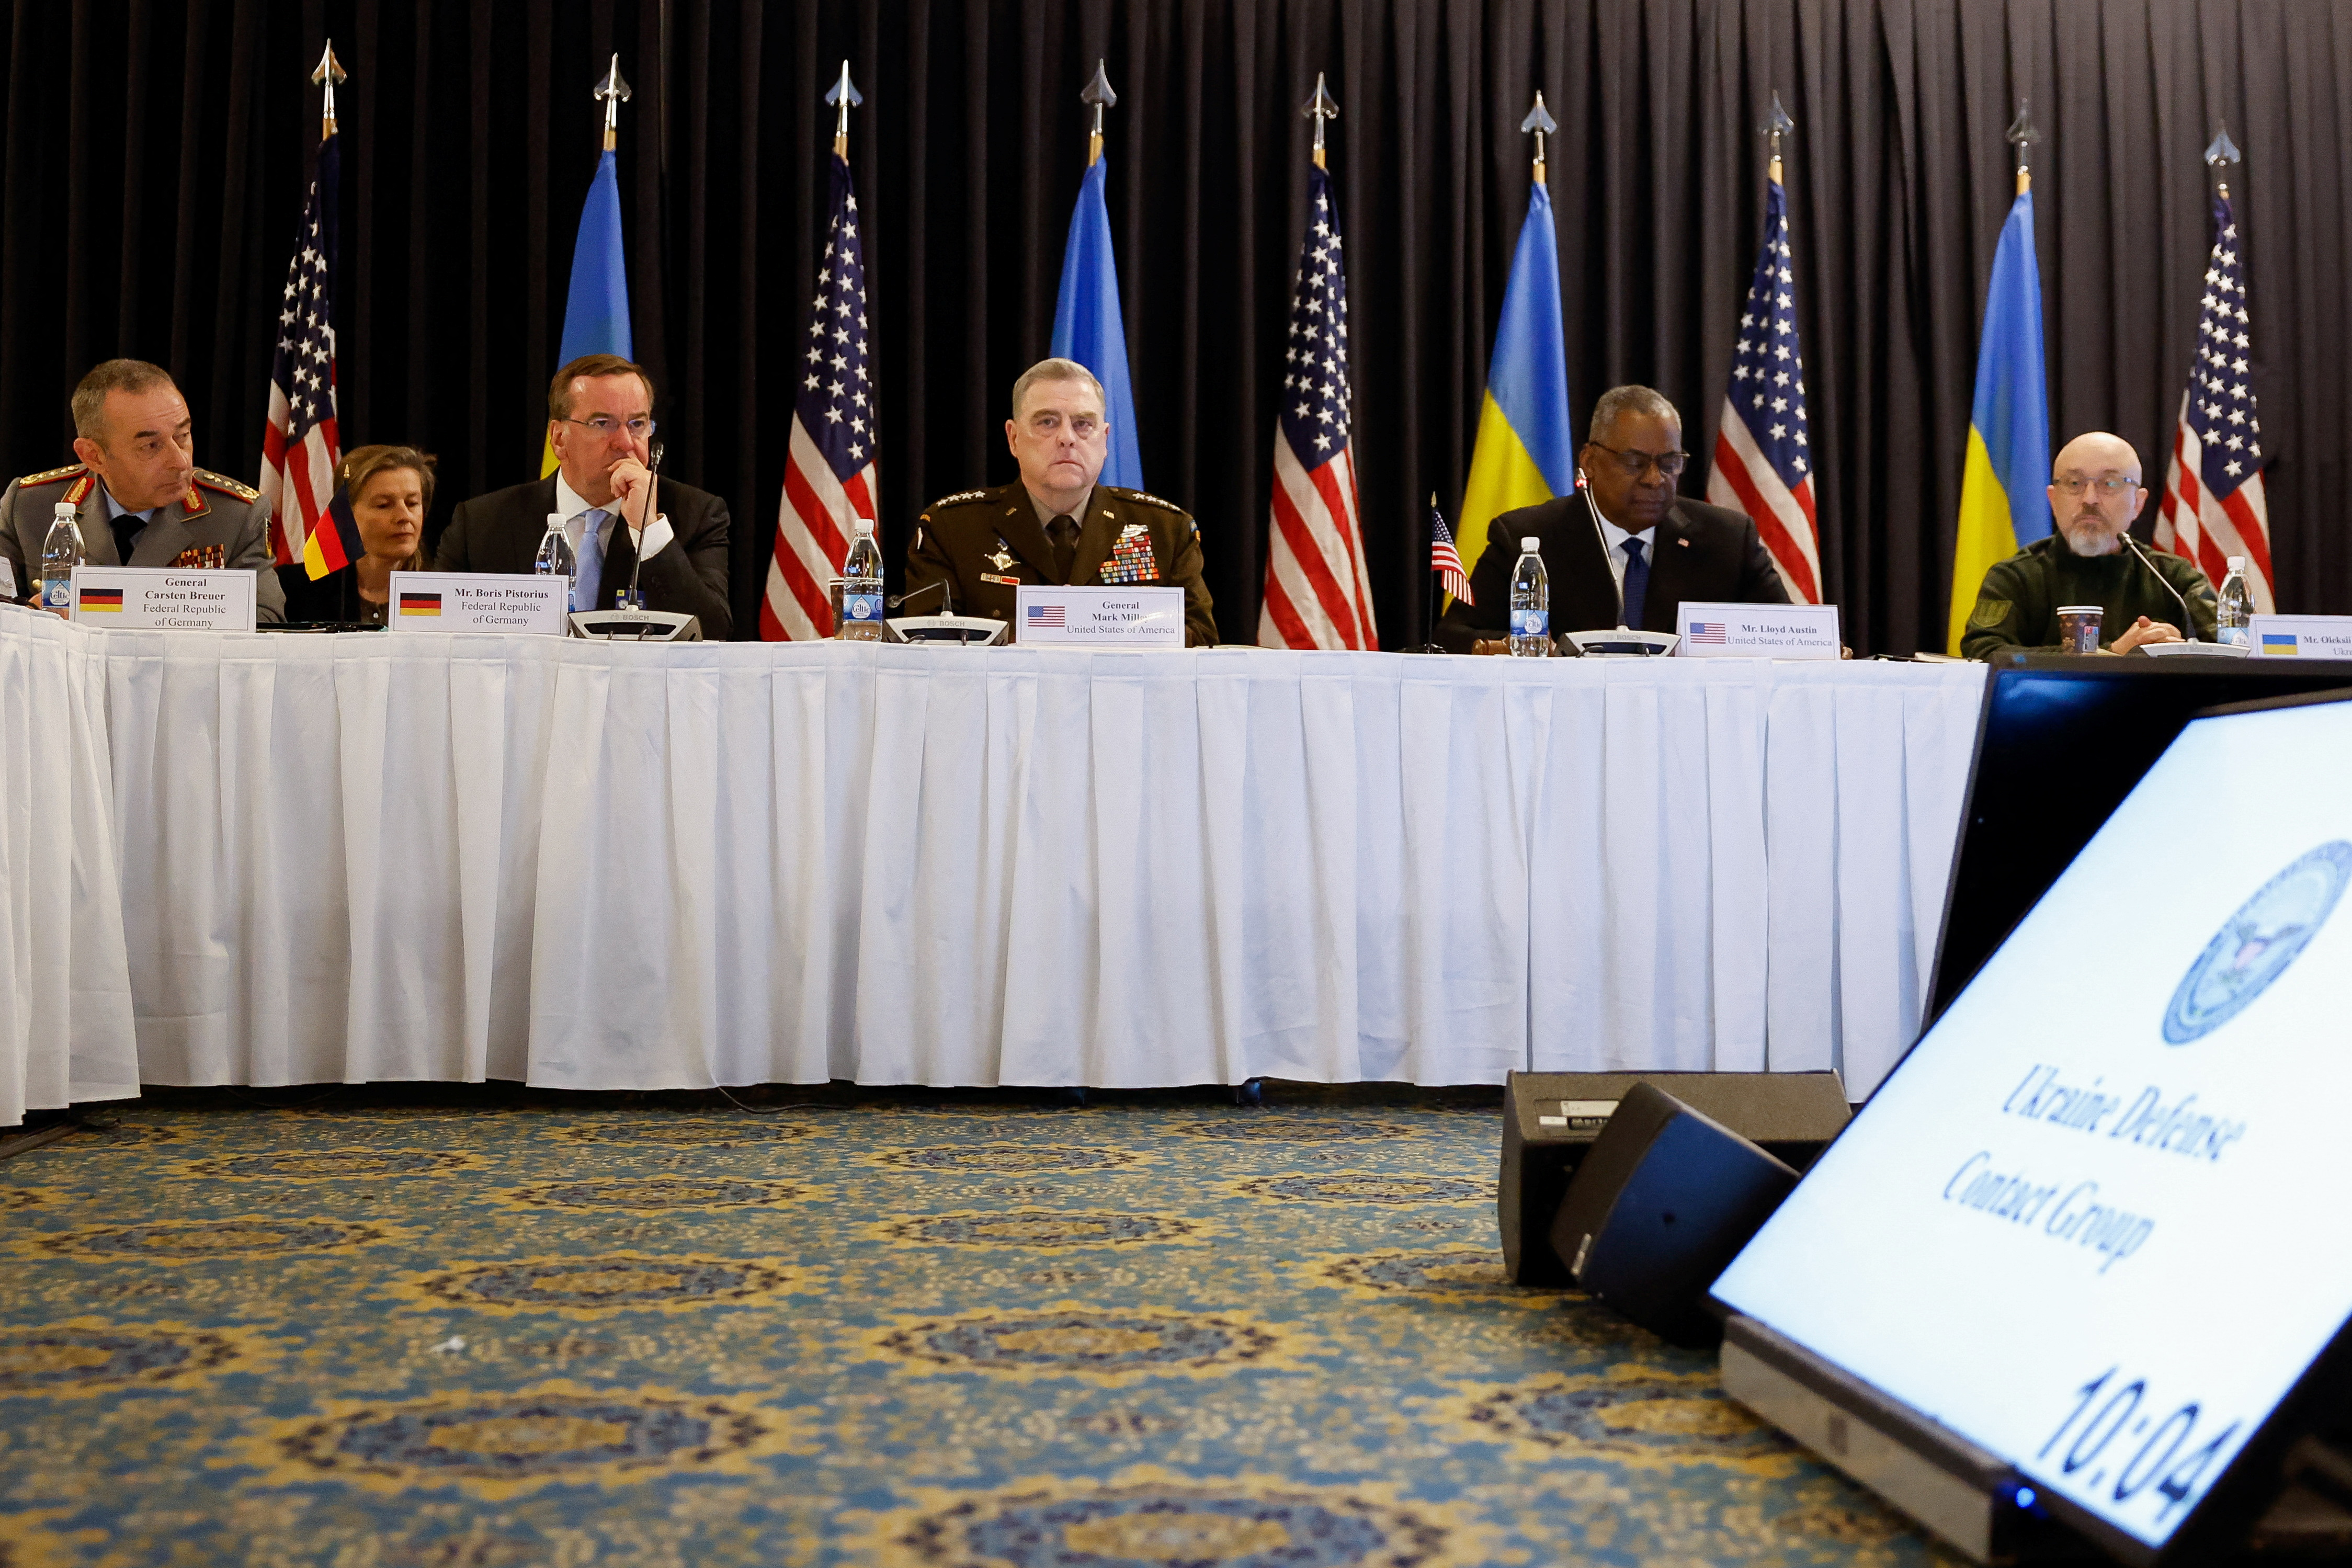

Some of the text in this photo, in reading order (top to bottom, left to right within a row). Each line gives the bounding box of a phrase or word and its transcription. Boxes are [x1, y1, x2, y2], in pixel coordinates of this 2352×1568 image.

[165, 577, 207, 587] General
[145, 590, 226, 600] Carsten Breuer
[455, 588, 549, 598] Mr. Boris Pistorius
[144, 604, 226, 615] Federal Republic
[461, 601, 541, 613] Federal Republic
[473, 615, 529, 627] of Germany
[1092, 613, 1118, 621] Mark
[155, 617, 213, 629] of Germany
[1127, 625, 1137, 633] of
[1760, 625, 1786, 635] Lloyd
[1758, 637, 1783, 645] States
[2002, 1063, 2247, 1163] Ukraine Defense
[1942, 1149, 2157, 1276] Contact Group
[2035, 1362, 2244, 1525] 10:04
